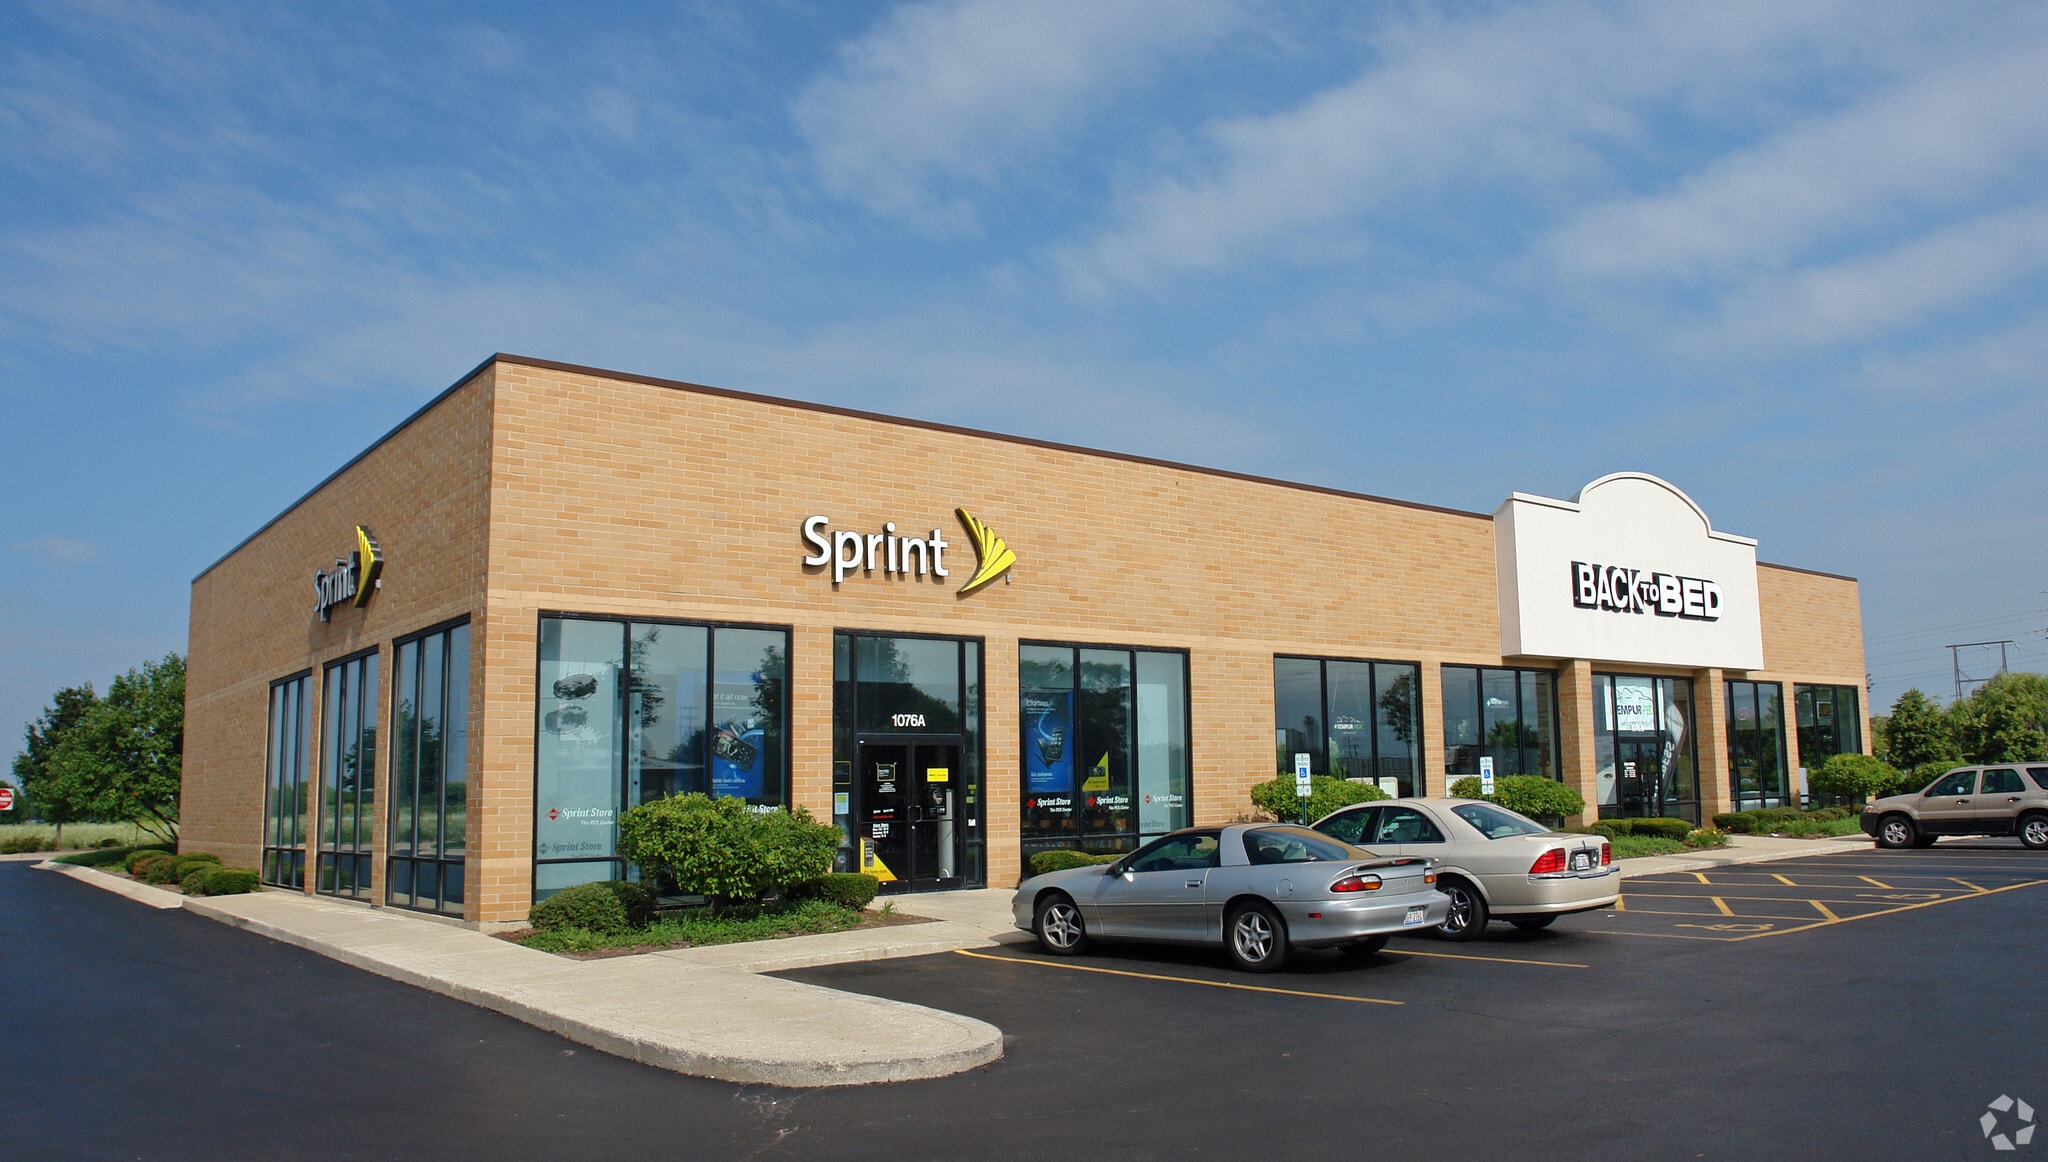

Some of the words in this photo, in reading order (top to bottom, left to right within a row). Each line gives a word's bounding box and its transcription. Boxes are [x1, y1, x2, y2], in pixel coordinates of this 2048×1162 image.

[802, 514, 949, 583] Sprint
[313, 551, 360, 622] Sprint
[1571, 561, 1644, 614] BACK
[1640, 582, 1660, 603] TO
[1652, 572, 1724, 622] BED
[1617, 704, 1642, 715] EMPUR
[891, 714, 926, 727] 1076A
[1037, 798, 1055, 808] Sprint
[1056, 797, 1071, 806] Store
[1096, 796, 1114, 805] Sprint
[1114, 796, 1129, 804] Store
[1153, 794, 1169, 803] Sprint
[1169, 794, 1183, 802] Store
[561, 808, 590, 819] Sprint
[590, 807, 613, 817] Store
